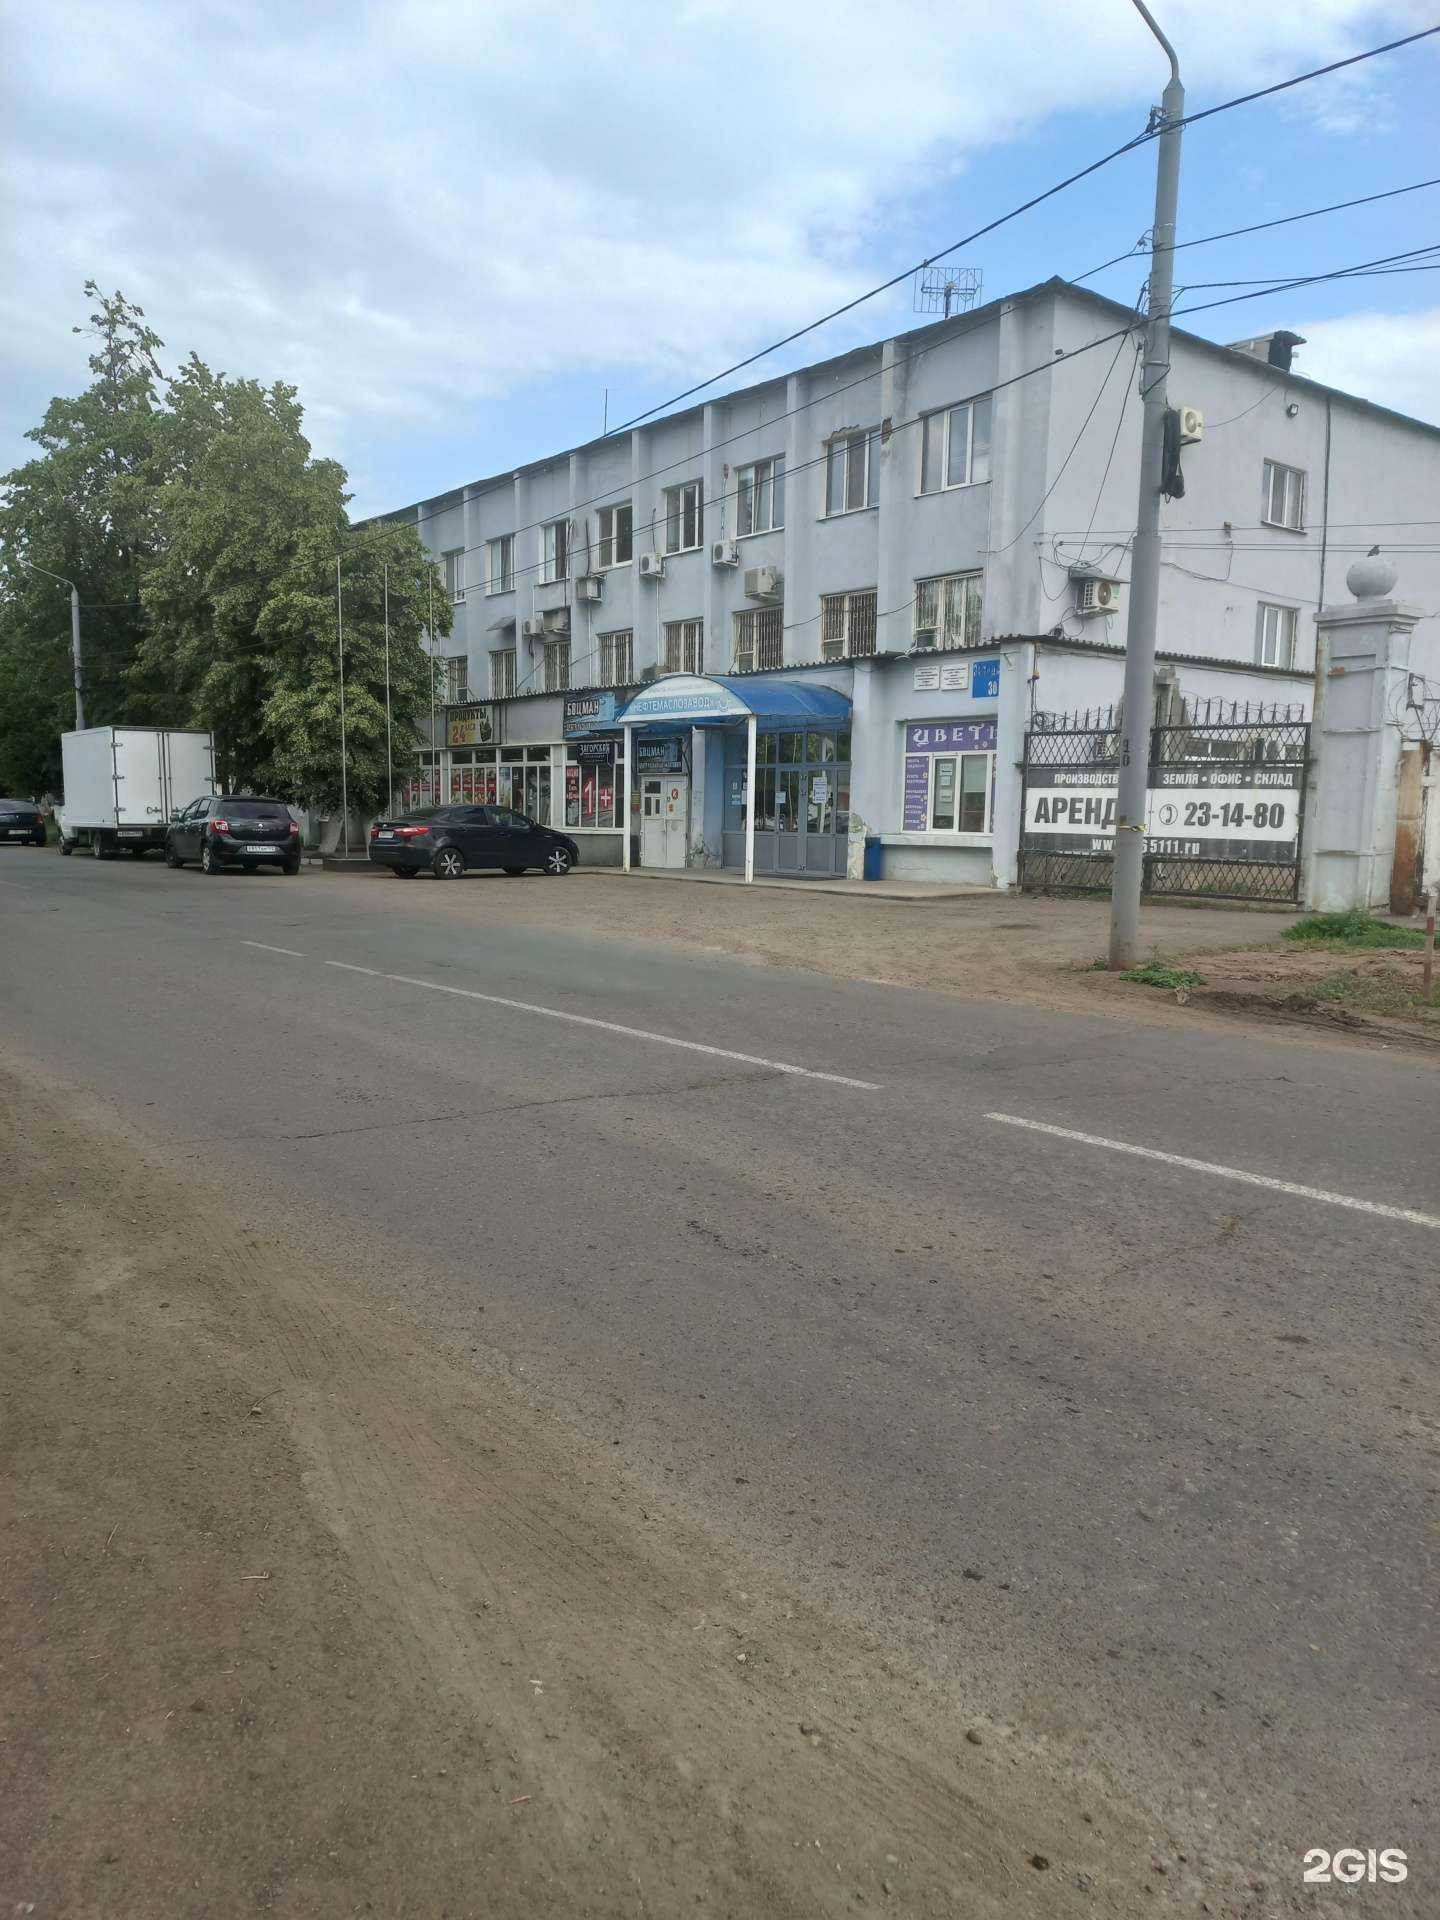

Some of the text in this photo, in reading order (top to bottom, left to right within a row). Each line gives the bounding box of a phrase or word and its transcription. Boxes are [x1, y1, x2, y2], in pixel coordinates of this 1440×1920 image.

[988, 681, 998, 696] 30
[450, 707, 487, 722] ПРОДУКТЫ
[567, 700, 599, 716] БОЦМАН
[452, 724, 466, 744] 24
[1054, 773, 1294, 787] ПРОИЗВОДСТВ ЗЕМЛЯ ОФИС СКЛАД
[1034, 797, 1286, 830] АРЕНД 23-14-80
